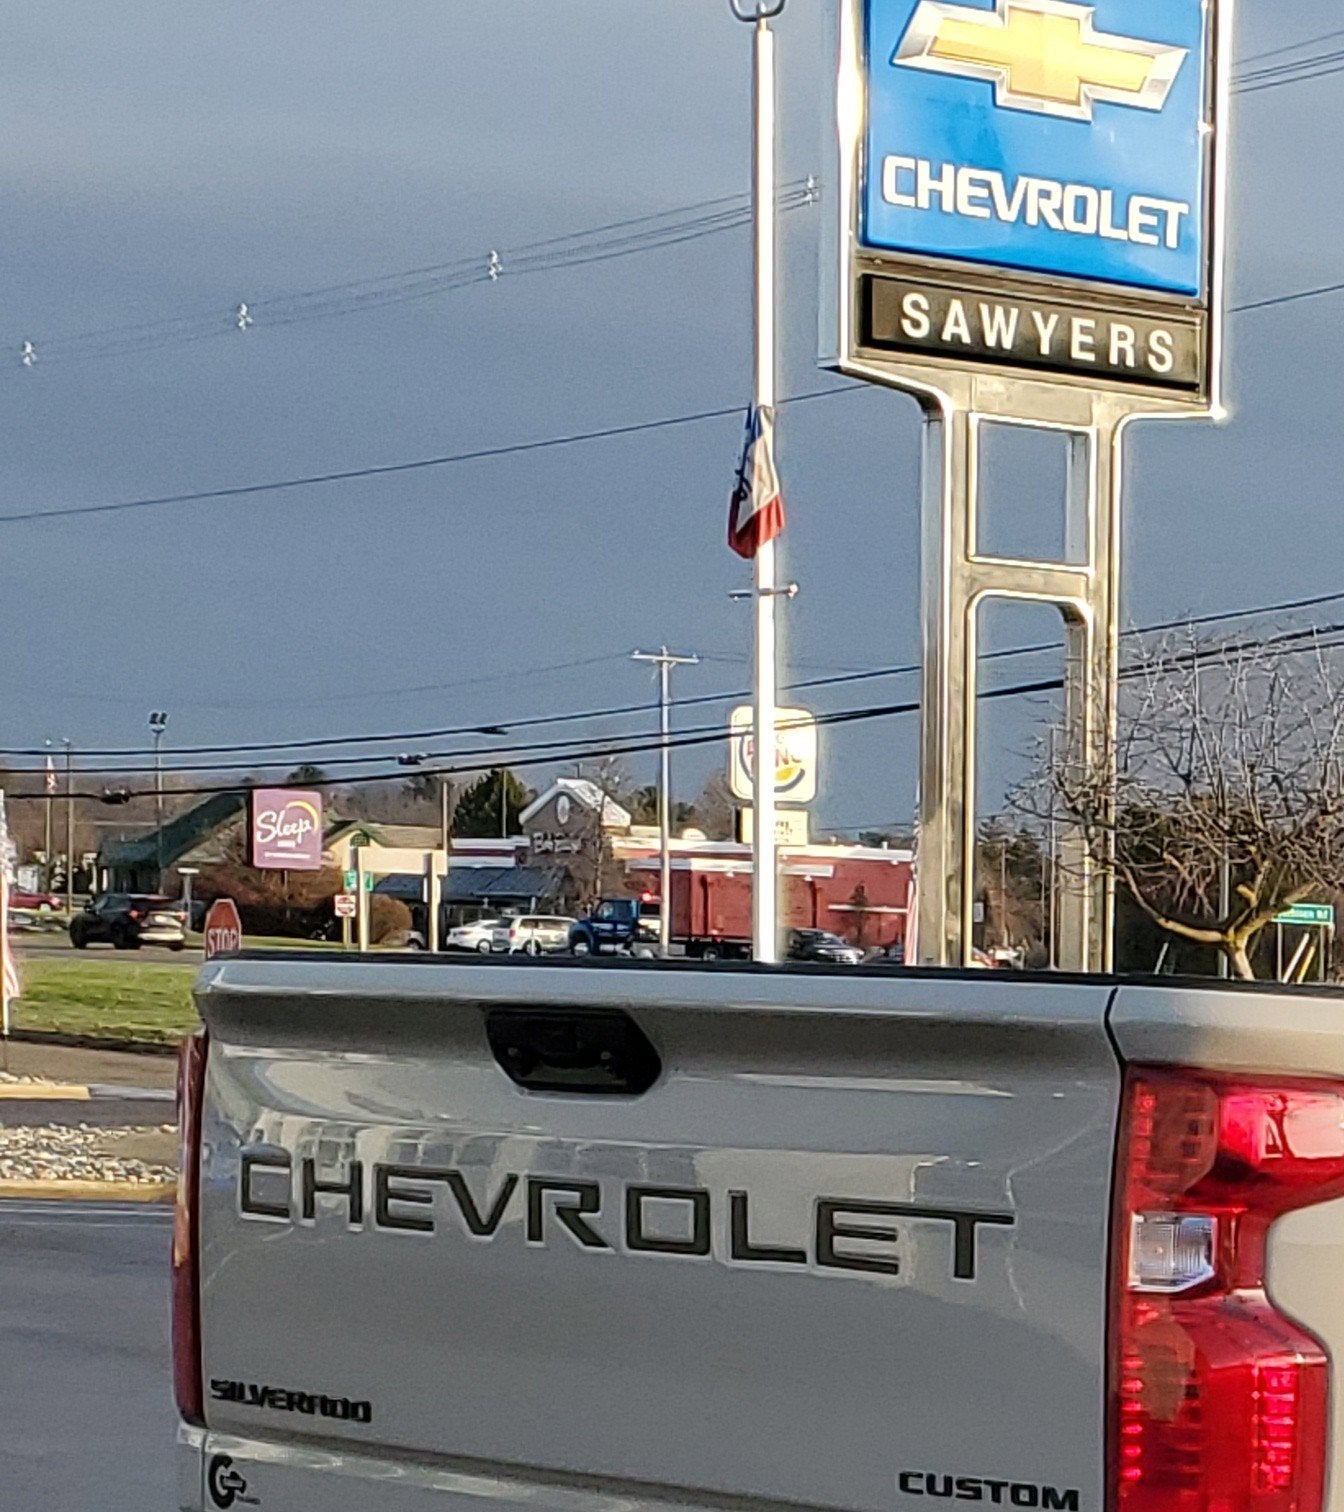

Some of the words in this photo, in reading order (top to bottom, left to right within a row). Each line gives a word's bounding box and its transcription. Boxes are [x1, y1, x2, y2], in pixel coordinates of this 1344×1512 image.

[882, 155, 1190, 249] CHEVROLET
[901, 293, 1175, 373] SAWYERS
[256, 809, 312, 844] Sleep
[207, 927, 240, 959] STOP
[239, 1150, 1015, 1279] CHEVROLET
[211, 1378, 372, 1423] SILVERADO
[899, 1470, 1079, 1512] CUSTOM
